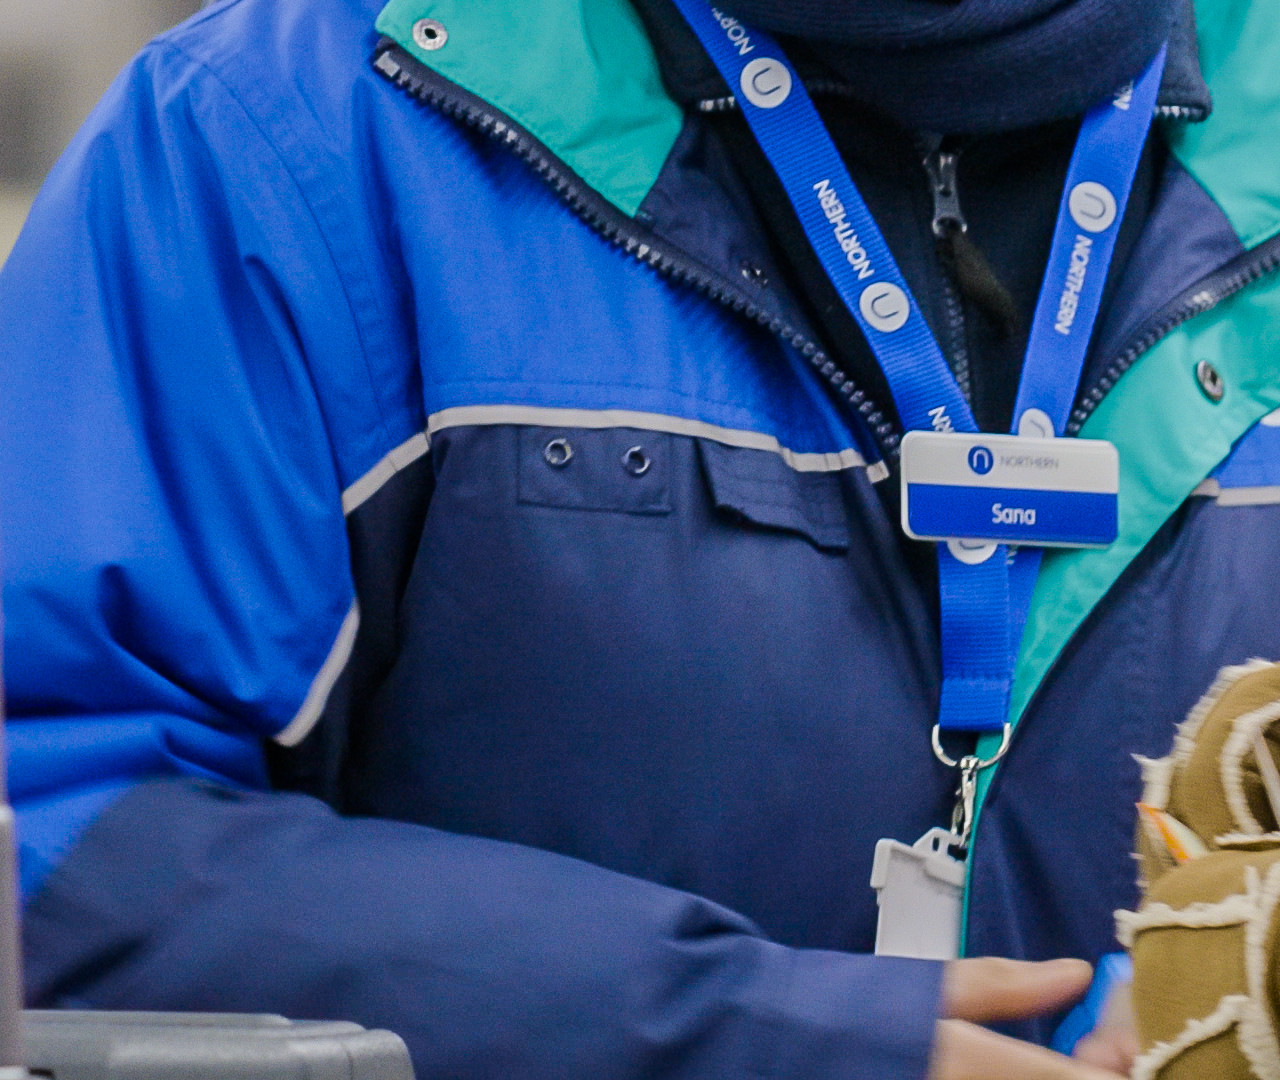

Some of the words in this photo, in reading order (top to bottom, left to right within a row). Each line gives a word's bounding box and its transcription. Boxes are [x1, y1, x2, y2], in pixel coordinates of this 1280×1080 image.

[813, 179, 875, 280] NORTHERN
[1054, 234, 1093, 336] NORTHERN
[1000, 456, 1059, 470] NORTHERN
[991, 503, 1036, 526] Sana
